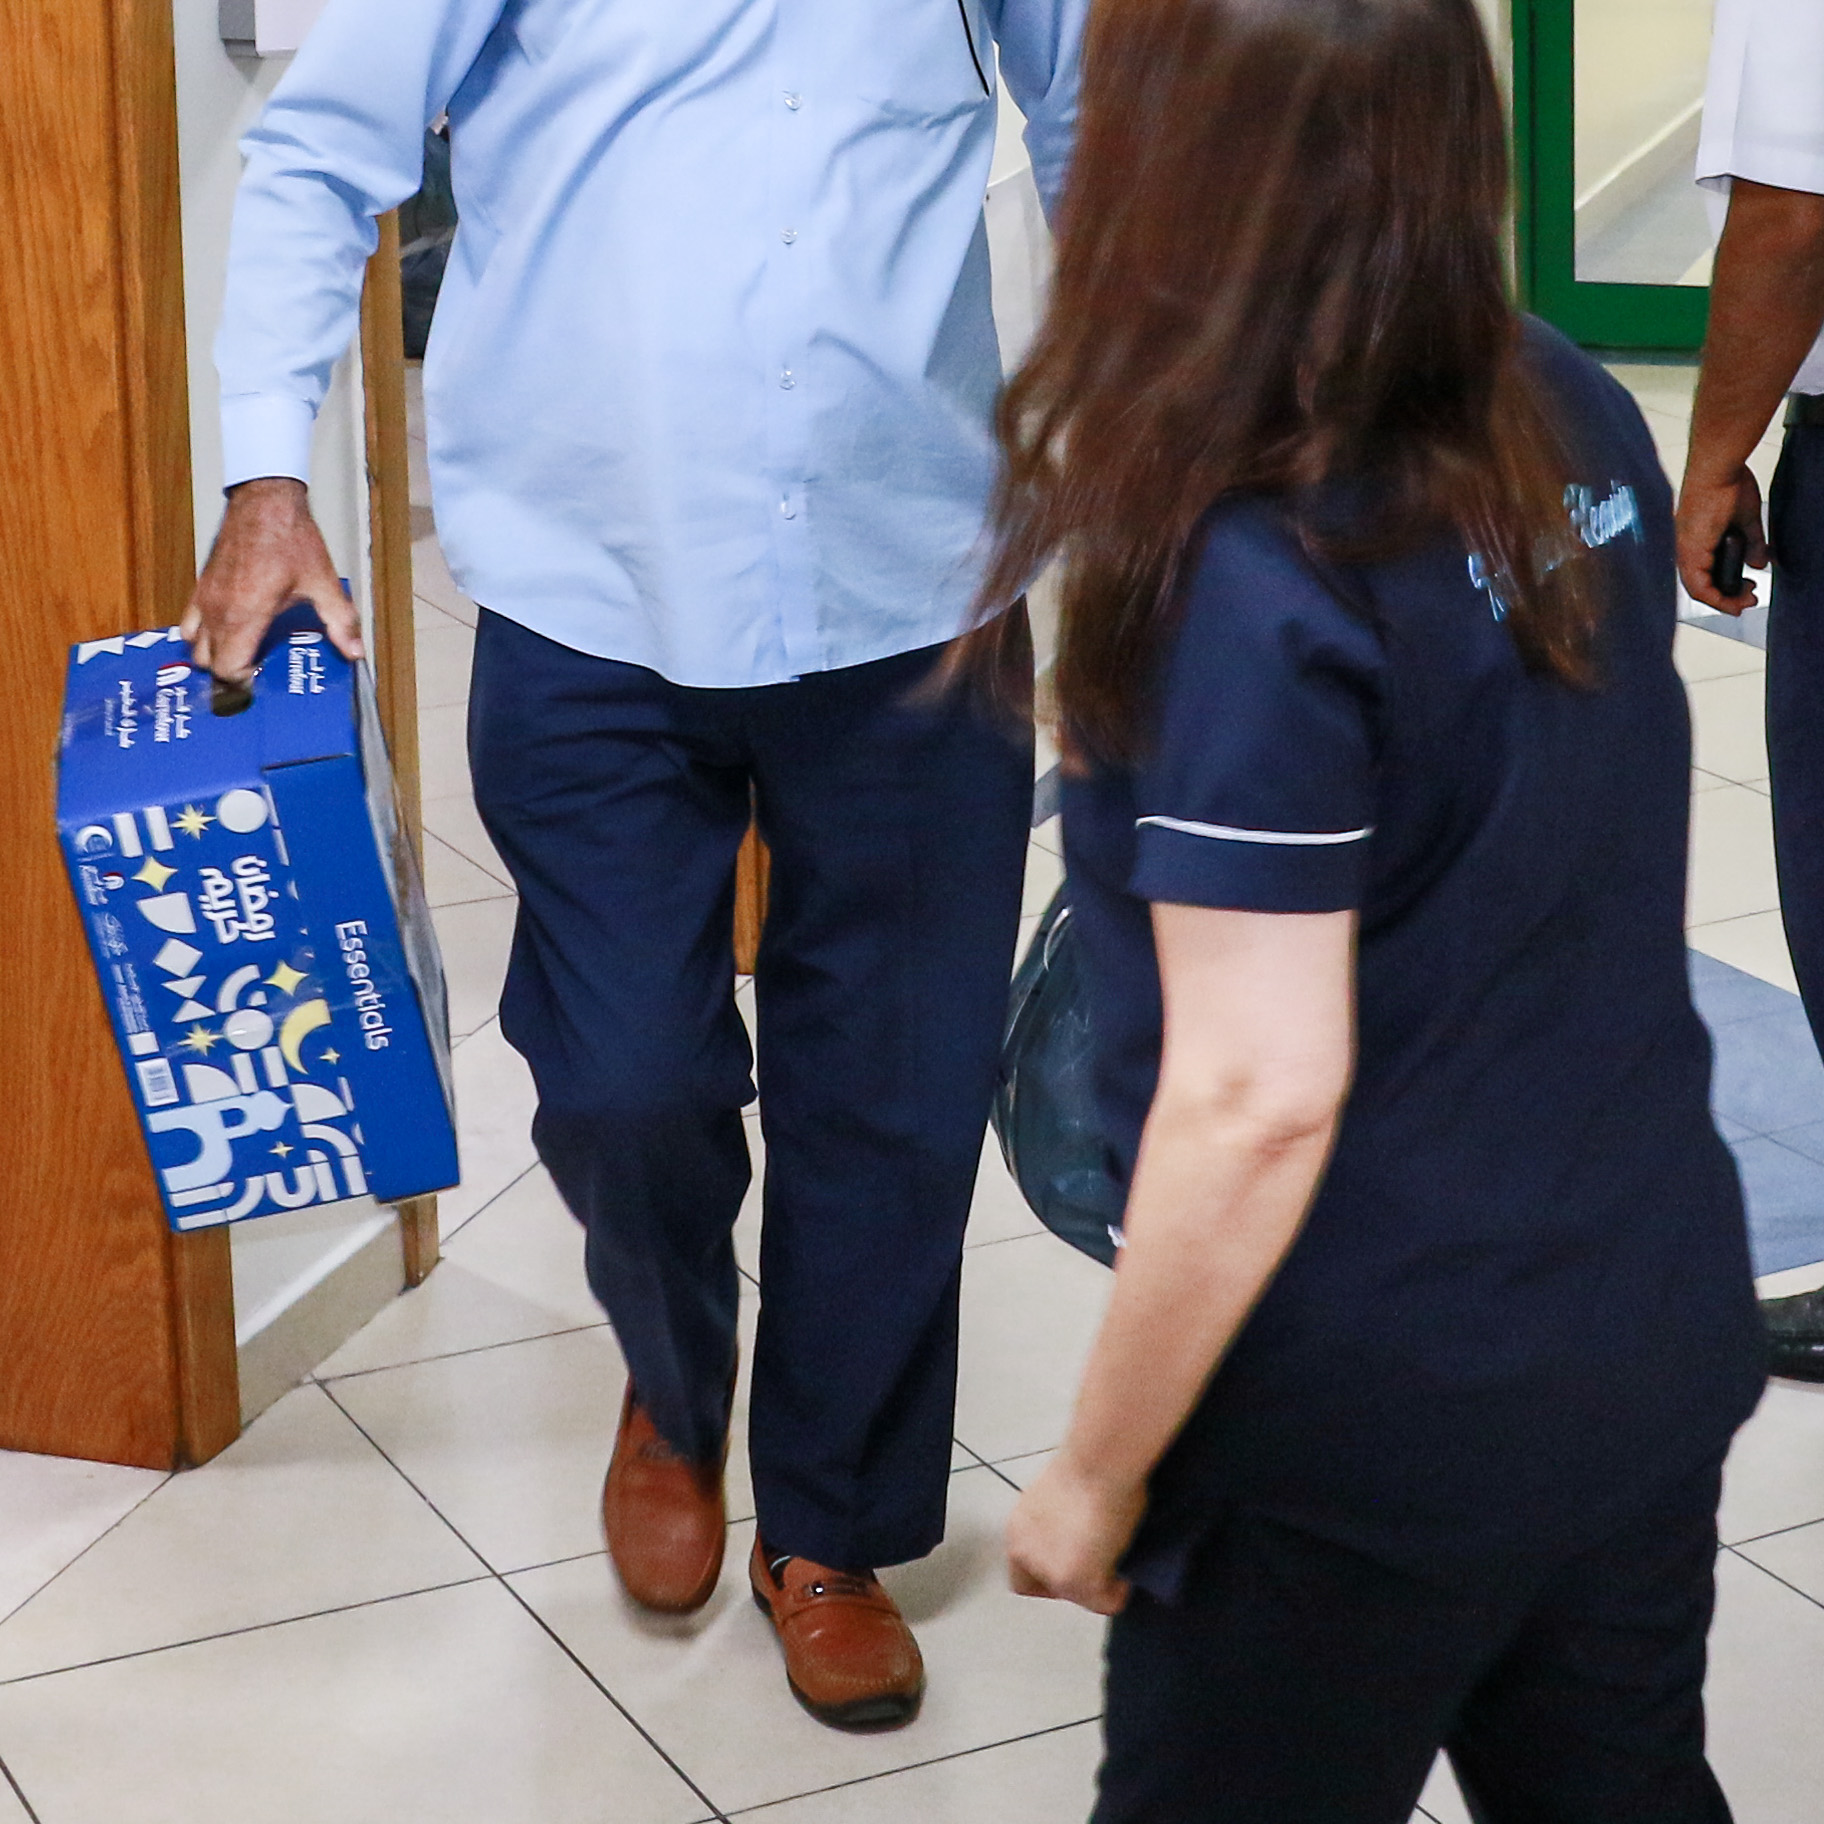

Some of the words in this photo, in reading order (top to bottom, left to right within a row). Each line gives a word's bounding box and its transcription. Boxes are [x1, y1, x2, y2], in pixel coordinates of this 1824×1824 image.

[197, 866, 248, 945] كريم
[230, 855, 280, 942] رمضان
[334, 919, 394, 1051] Essentials
